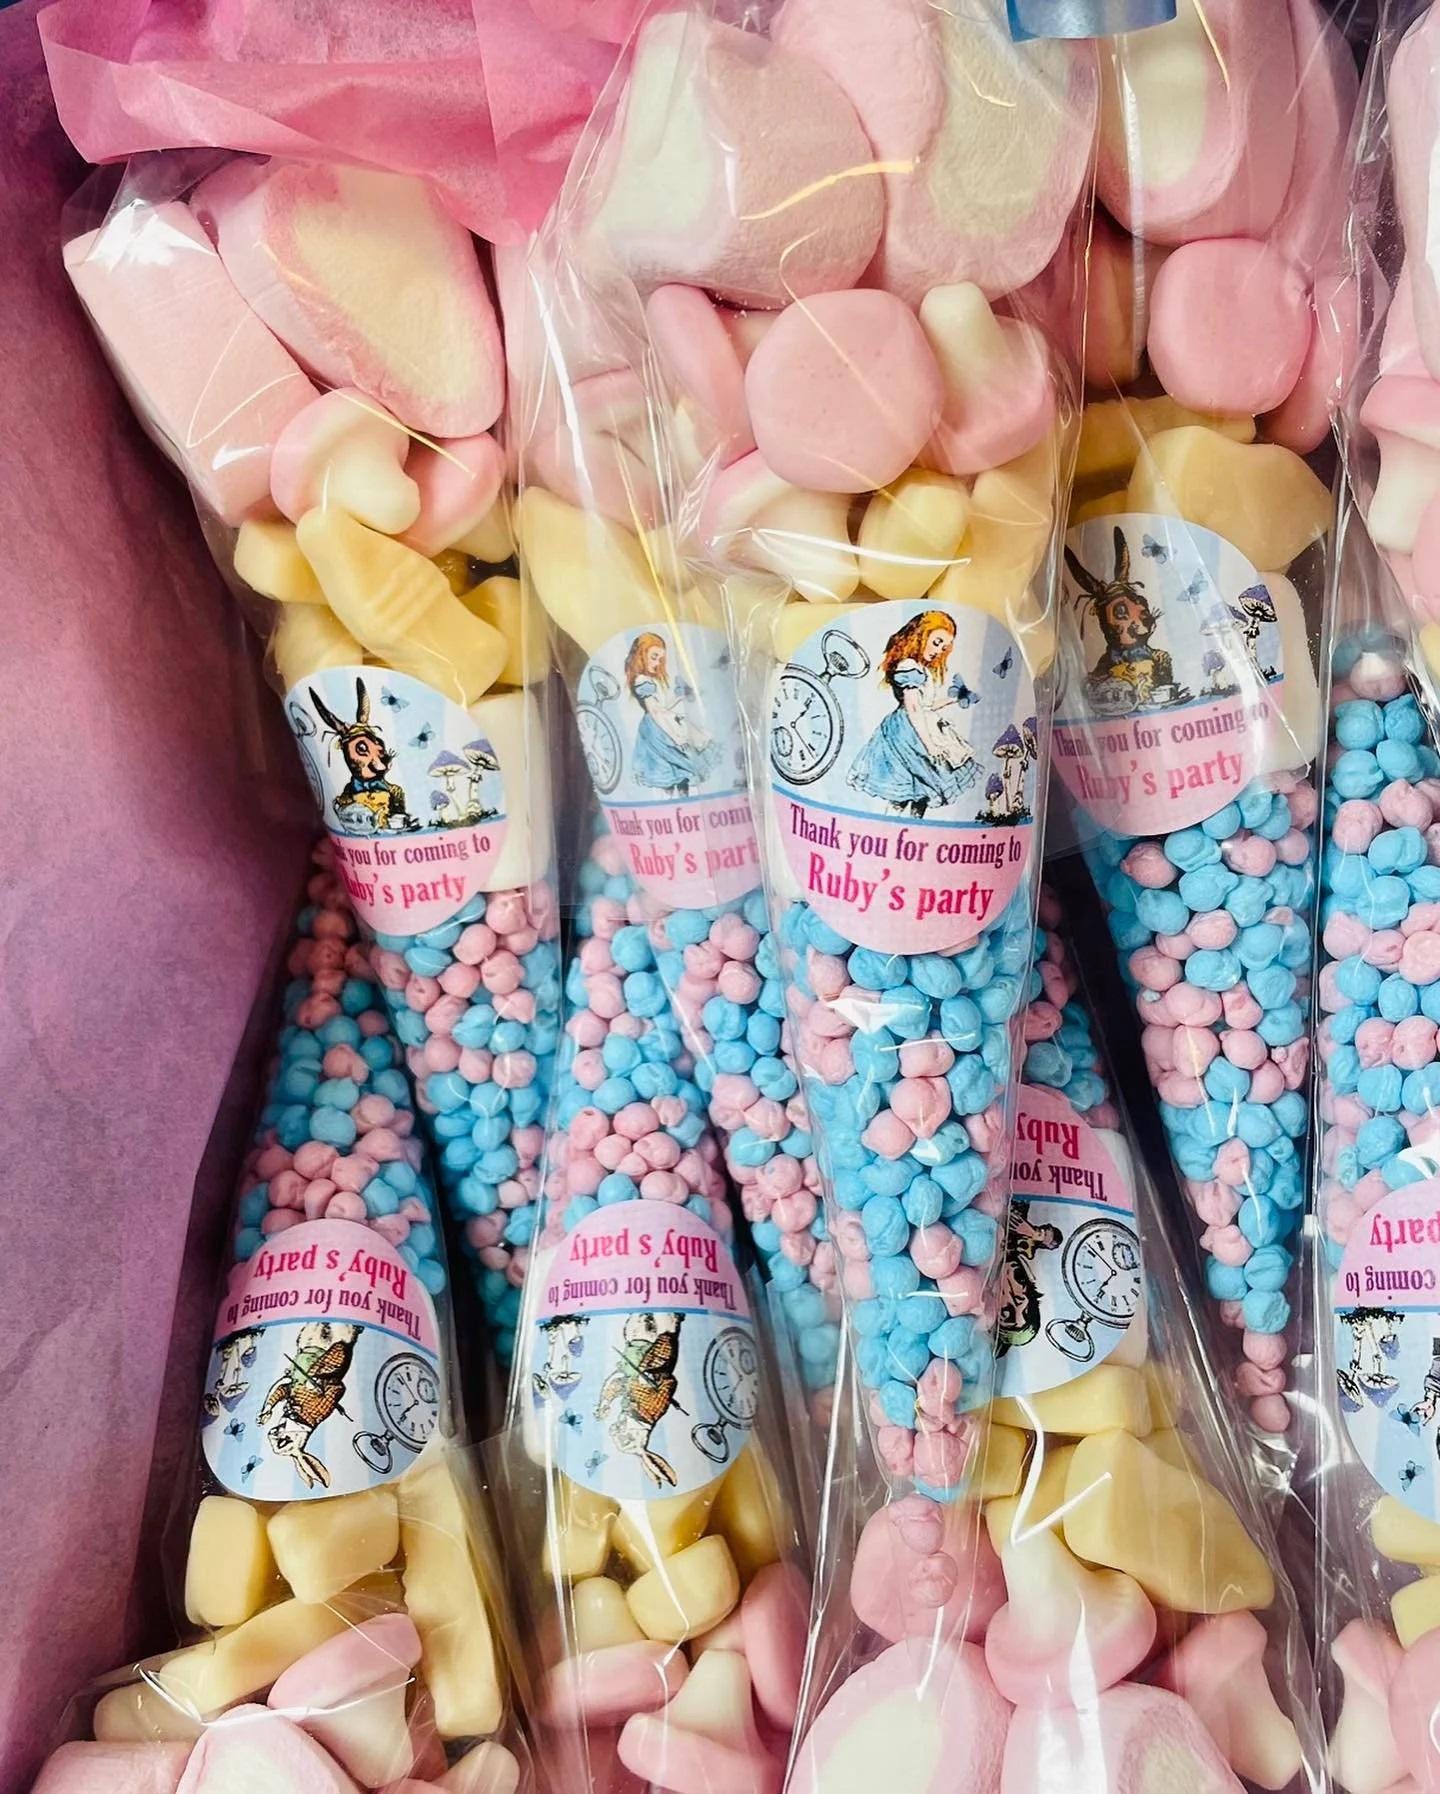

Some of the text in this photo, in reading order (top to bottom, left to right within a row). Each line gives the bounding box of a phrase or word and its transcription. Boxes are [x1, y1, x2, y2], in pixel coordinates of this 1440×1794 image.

[1133, 720, 1162, 750] for
[1170, 707, 1246, 743] coming
[1167, 750, 1244, 798] party
[609, 799, 754, 839] Thank you for comi
[790, 803, 1021, 869] Thank you for coming to
[349, 848, 371, 867] you
[374, 841, 397, 865] for
[404, 836, 469, 863] coming
[472, 833, 490, 854] to
[629, 836, 760, 880] Ruby's part
[401, 873, 466, 909] party
[808, 851, 994, 921] Ruby's party
[1017, 1112, 1080, 1160] Ruby
[1047, 1165, 1108, 1202] Thank
[253, 1244, 407, 1300] Ruby's party
[569, 1228, 720, 1273] Ruby's party
[548, 1272, 737, 1311] Thank you for coming to
[1345, 1265, 1436, 1300] coming to
[227, 1288, 422, 1341] Thank you for coming to
